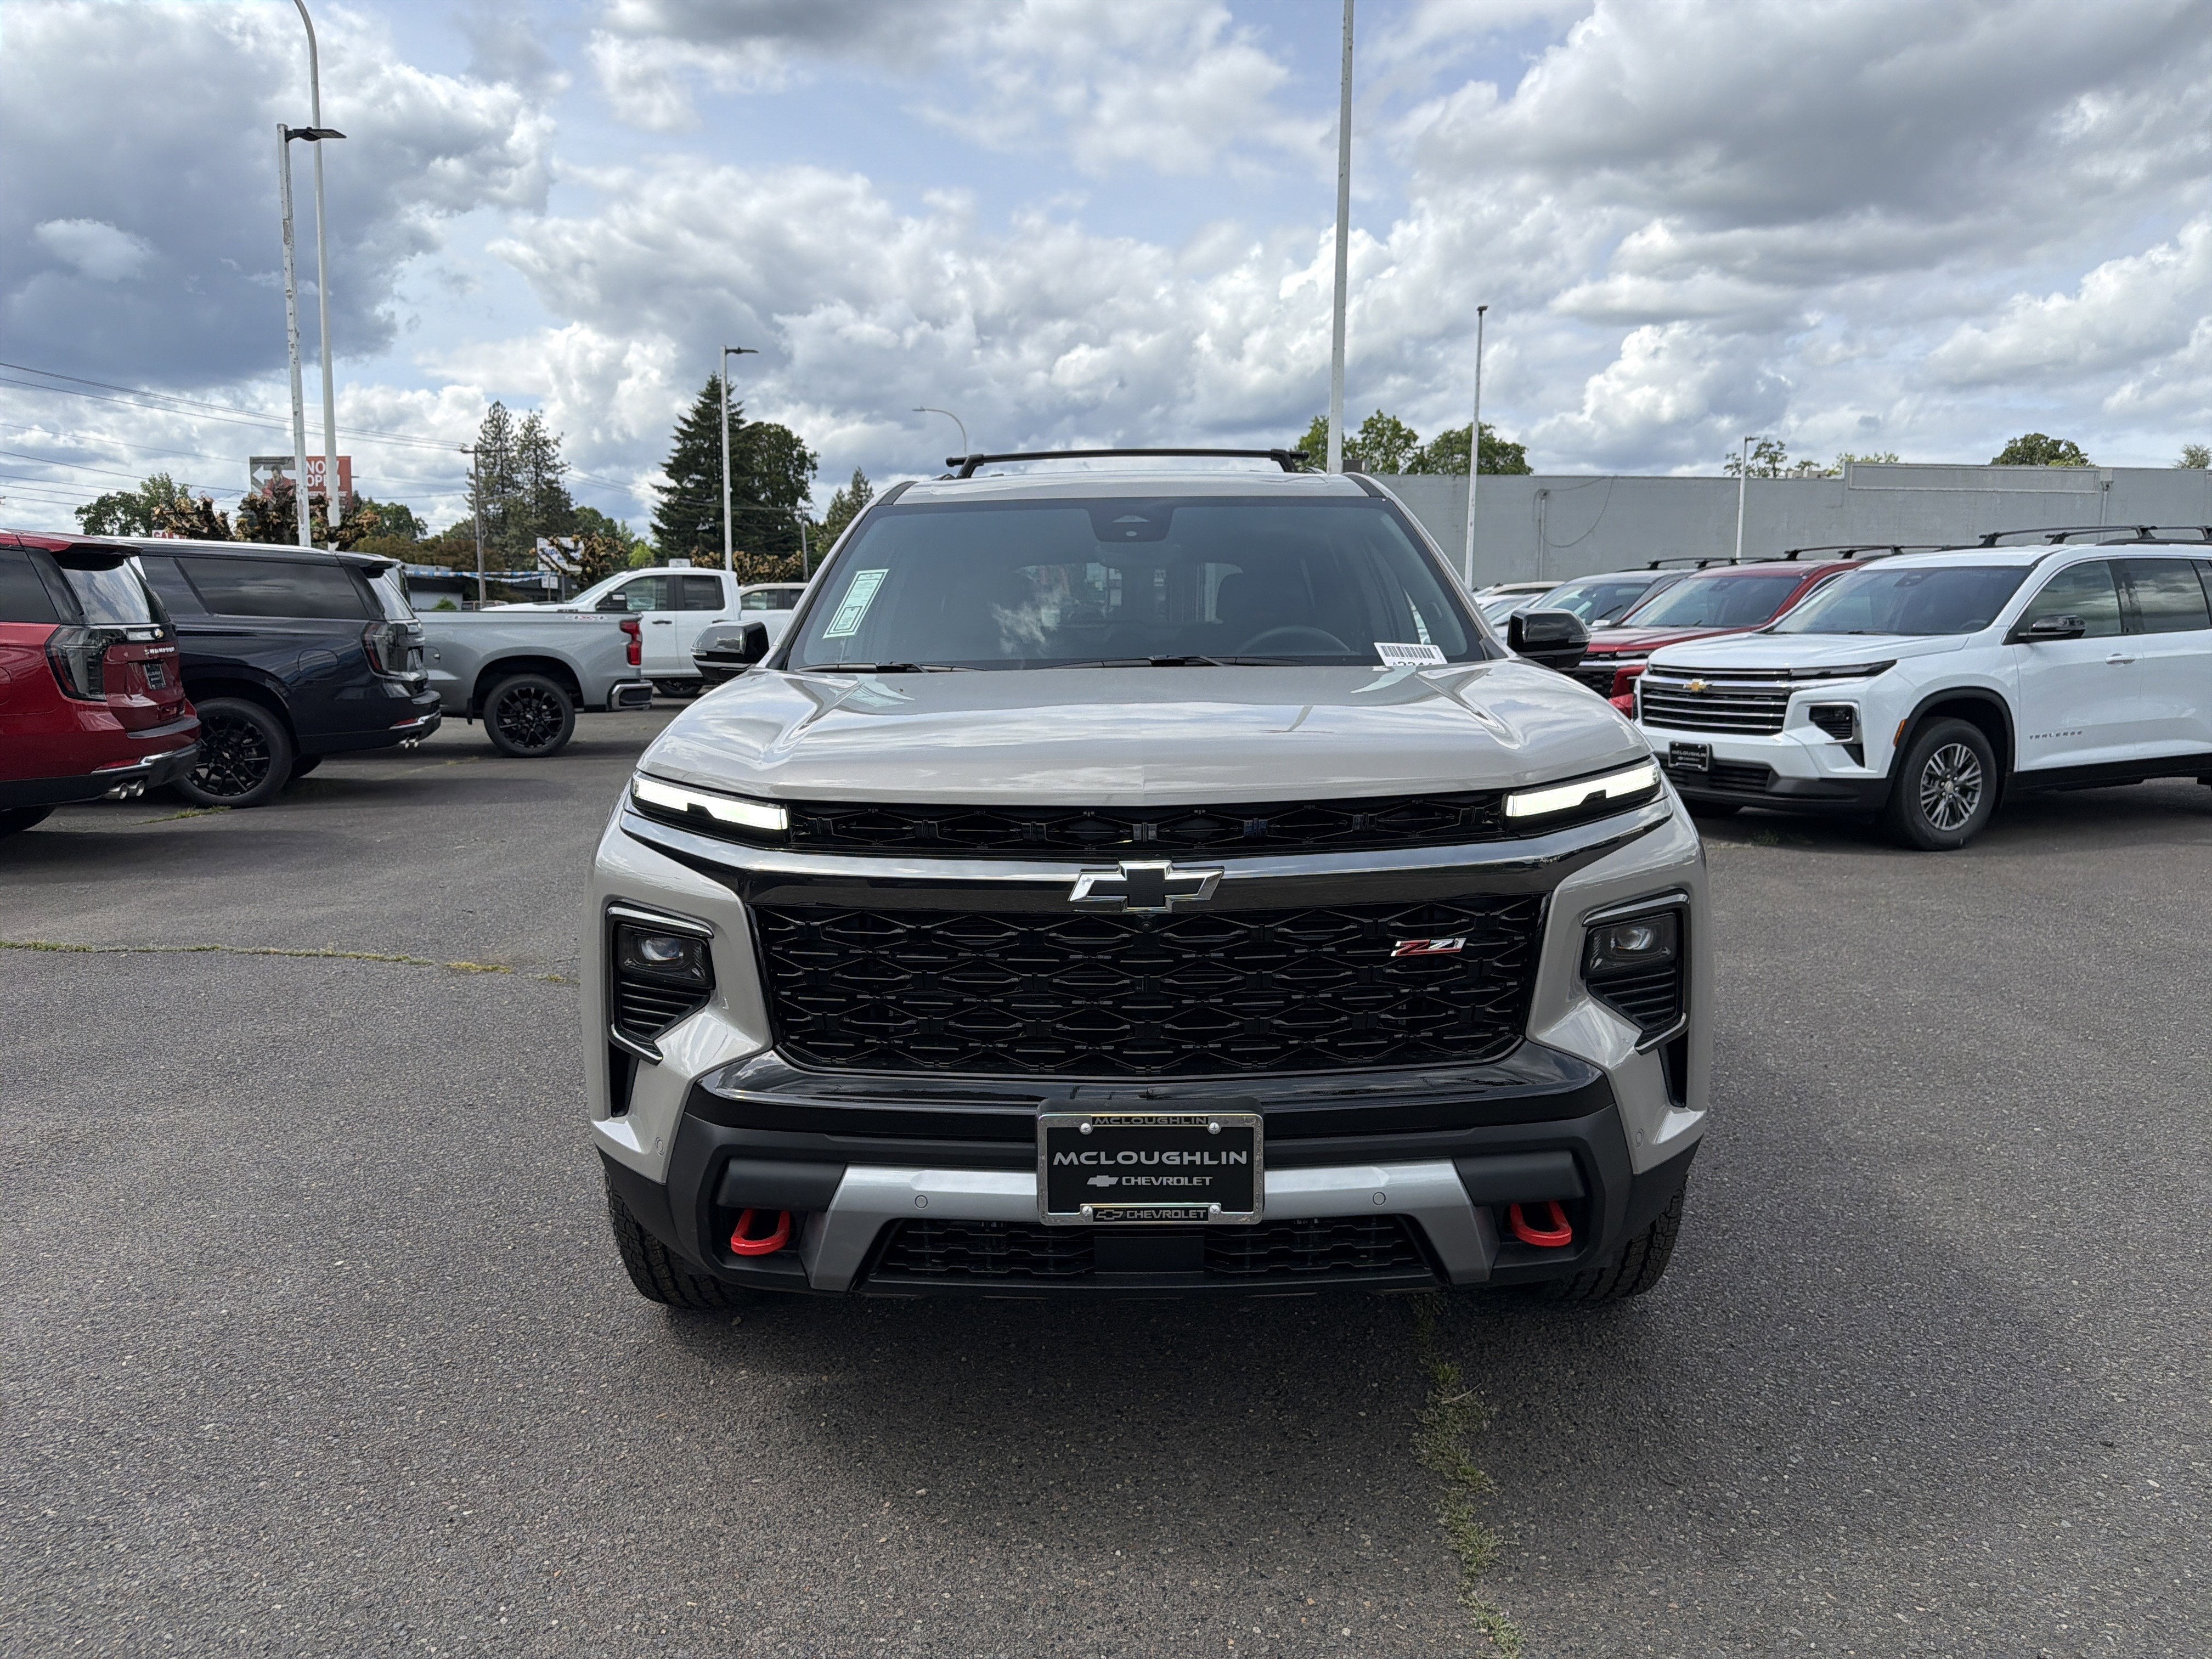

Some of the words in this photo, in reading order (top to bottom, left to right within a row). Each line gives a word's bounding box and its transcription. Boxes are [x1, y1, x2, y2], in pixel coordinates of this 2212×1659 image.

[306, 460, 340, 475] NO
[1390, 938, 1467, 957] Z71
[1053, 1151, 1247, 1165] MCLOUGHLIN
[1122, 1176, 1213, 1186] CHEVROLET
[1126, 1210, 1206, 1218] CHEVROLET
